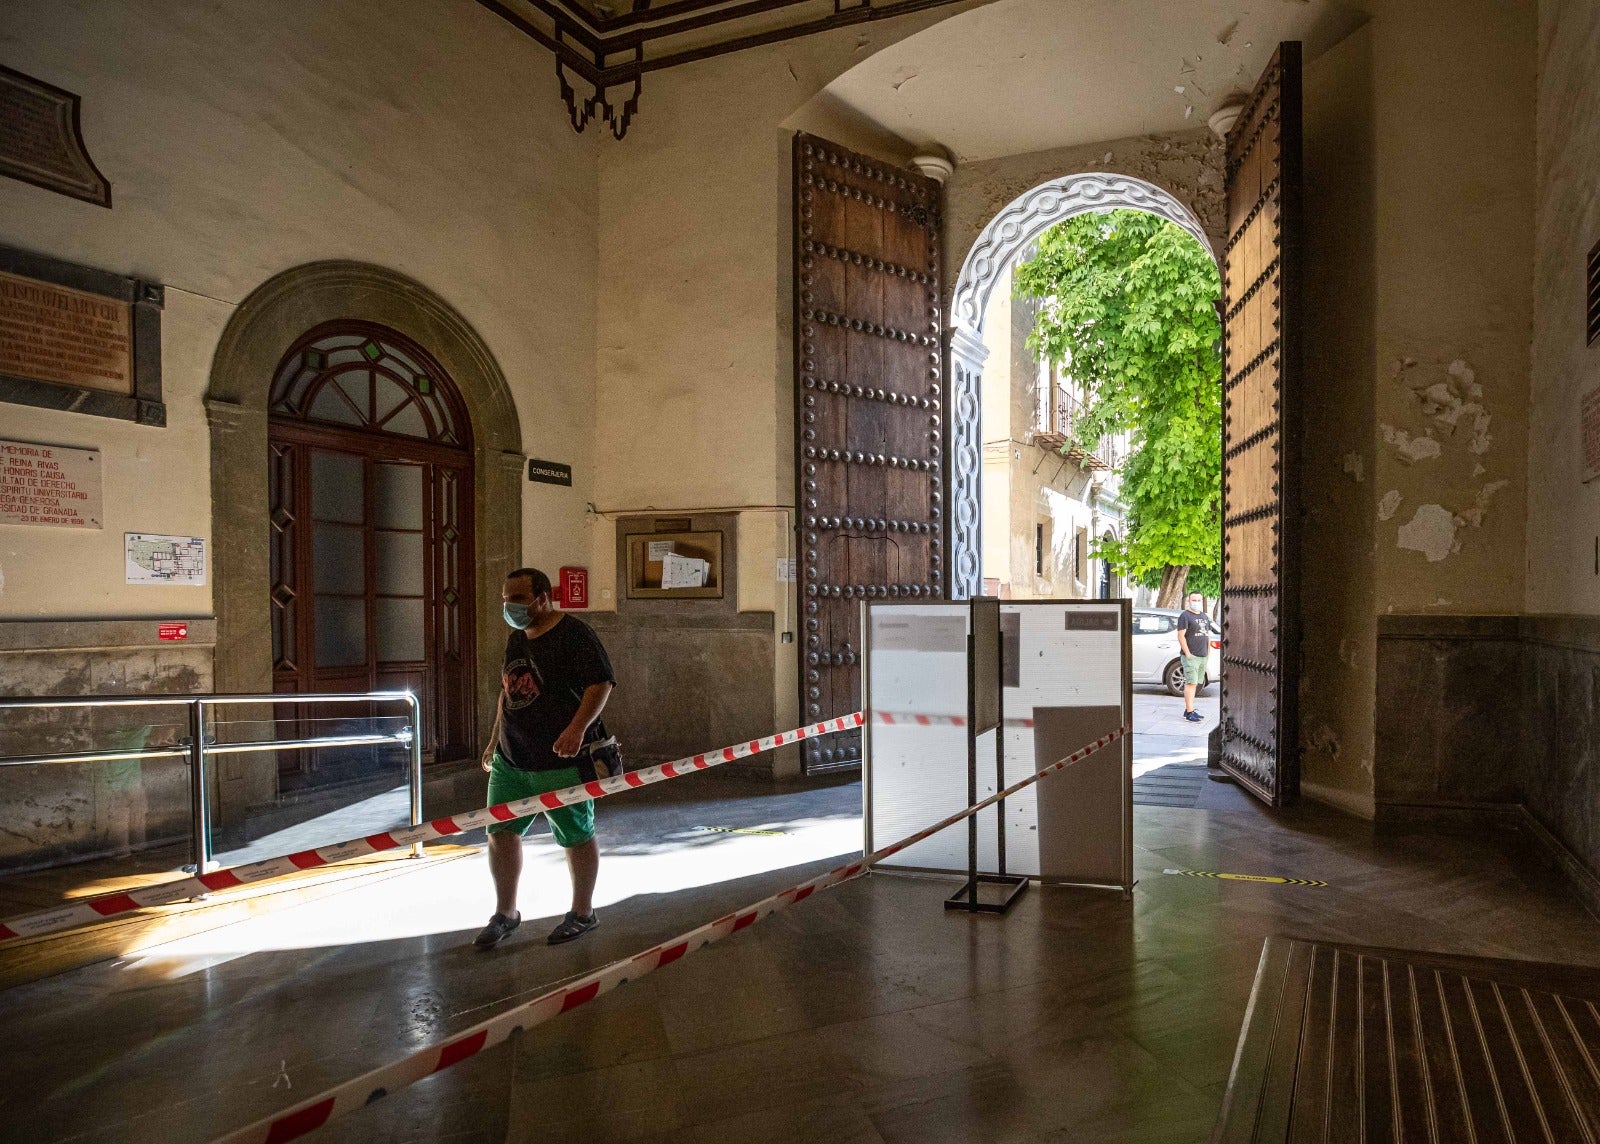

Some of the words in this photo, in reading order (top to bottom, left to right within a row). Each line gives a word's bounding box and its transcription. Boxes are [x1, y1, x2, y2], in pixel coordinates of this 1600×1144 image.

[1, 446, 39, 457] MEMORIA
[42, 450, 52, 458] DE
[9, 458, 32, 468] REINA
[37, 461, 59, 470] RIVAS
[4, 467, 38, 478] HONORIS
[40, 470, 66, 480] CAUSA
[28, 479, 38, 487] DE
[41, 480, 76, 490] DERECHO
[34, 488, 88, 500] UNIVERSITARIO
[20, 496, 60, 506] GENEROSA
[30, 506, 40, 514] DE
[43, 507, 78, 517] GRANADA
